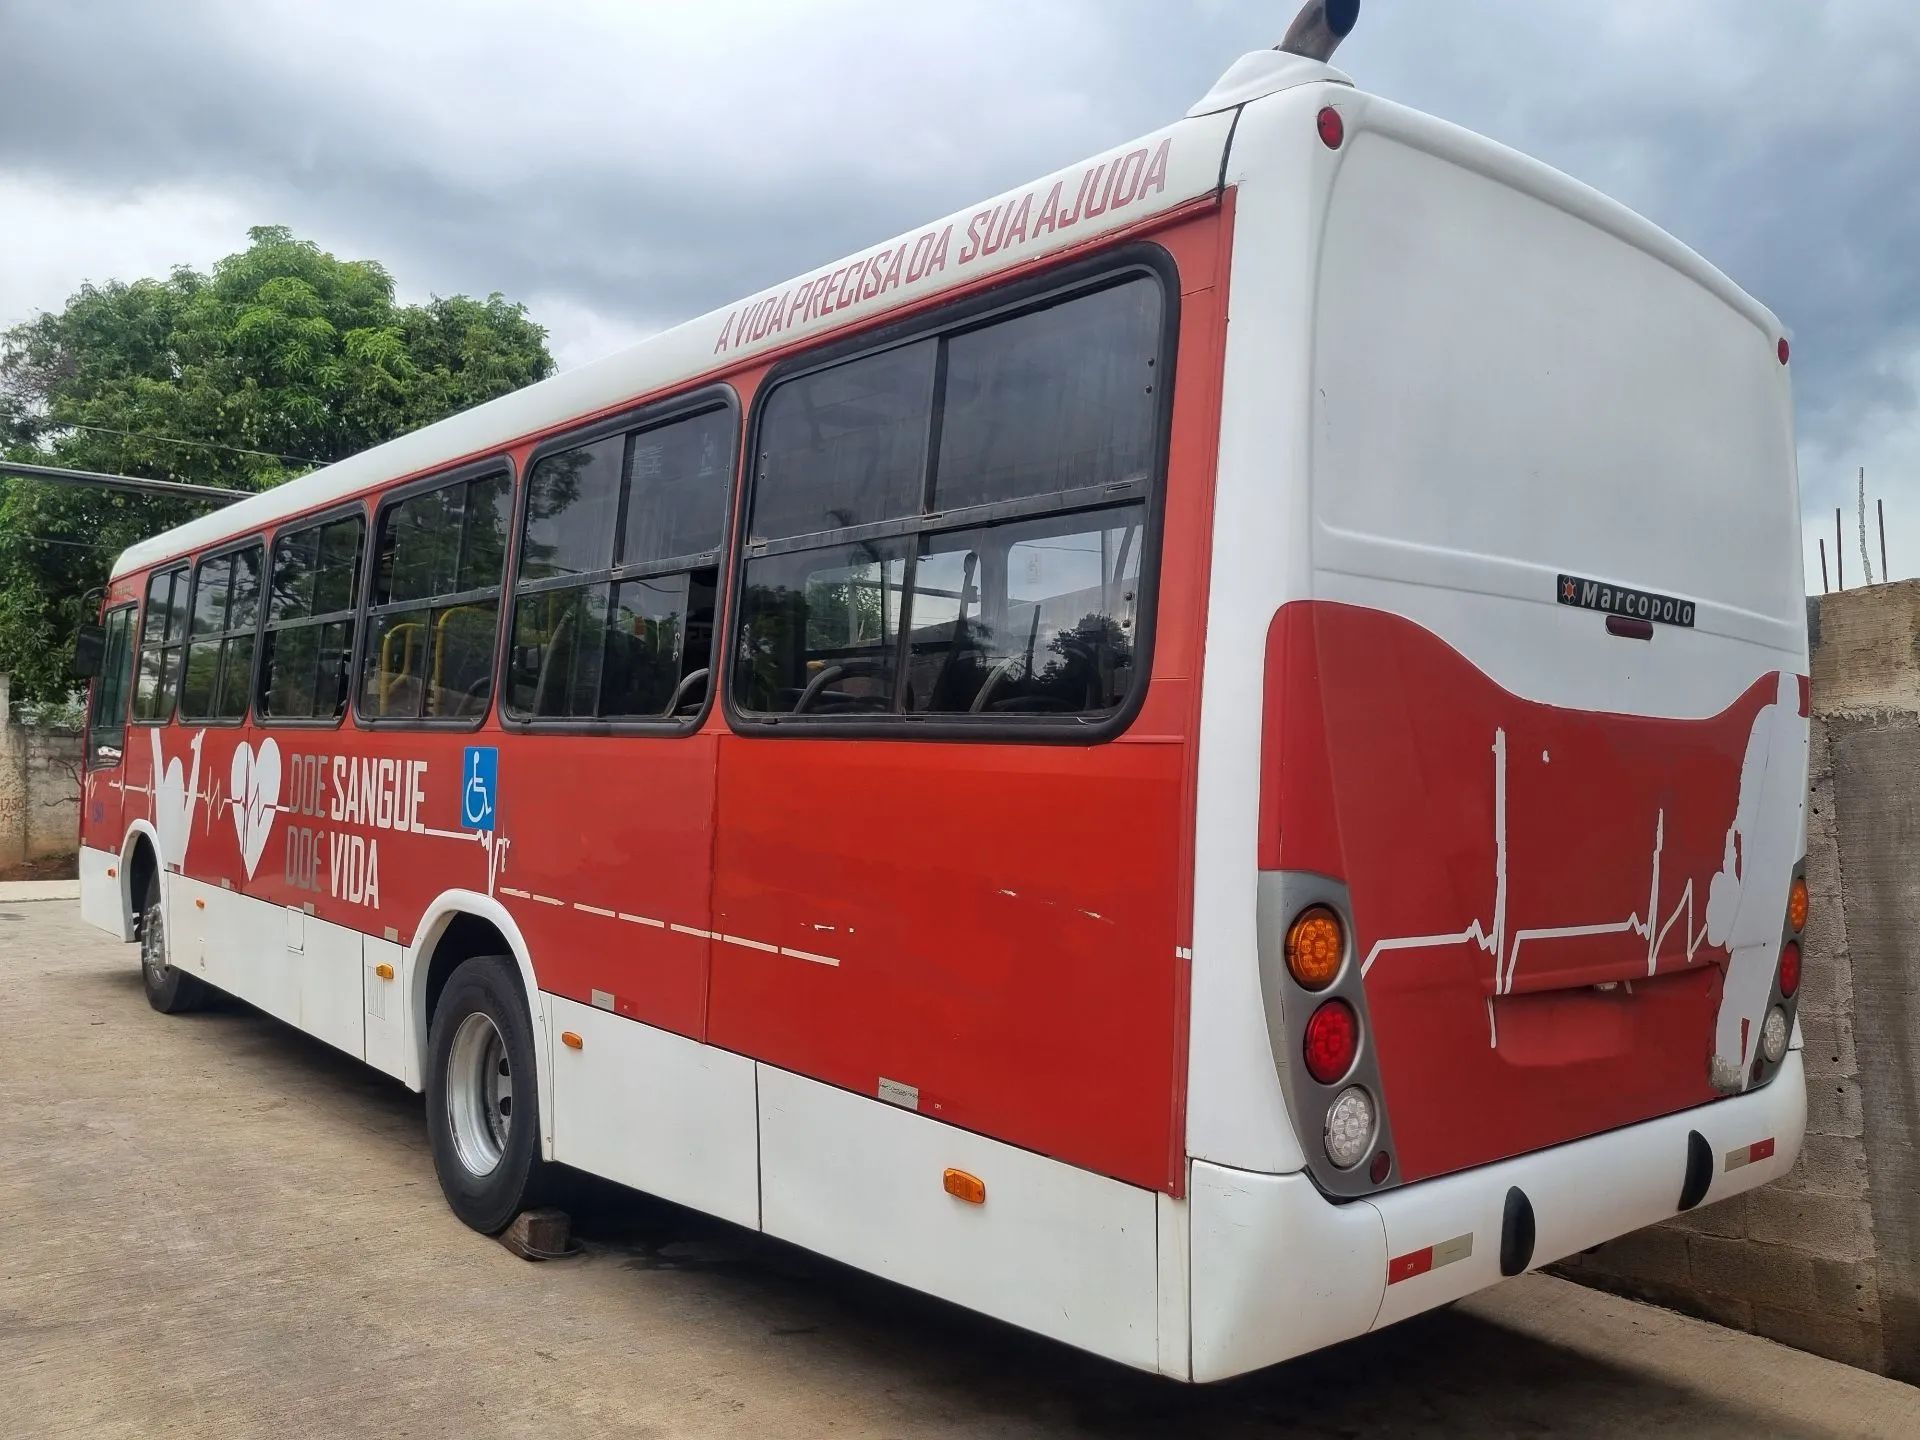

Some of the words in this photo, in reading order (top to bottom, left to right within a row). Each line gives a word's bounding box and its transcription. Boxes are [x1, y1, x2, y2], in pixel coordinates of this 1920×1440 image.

[714, 312, 736, 354] A
[735, 291, 790, 347] VIDA
[787, 243, 907, 328] PRECISA
[906, 224, 953, 284] DA
[958, 193, 1034, 264] SUA
[1032, 138, 1171, 239] AJUDA
[1581, 582, 1692, 624] Marcopolo
[290, 754, 328, 818] DOE
[331, 756, 427, 834] SANGUE
[286, 825, 324, 893] DOE
[331, 832, 379, 909] VIDA
